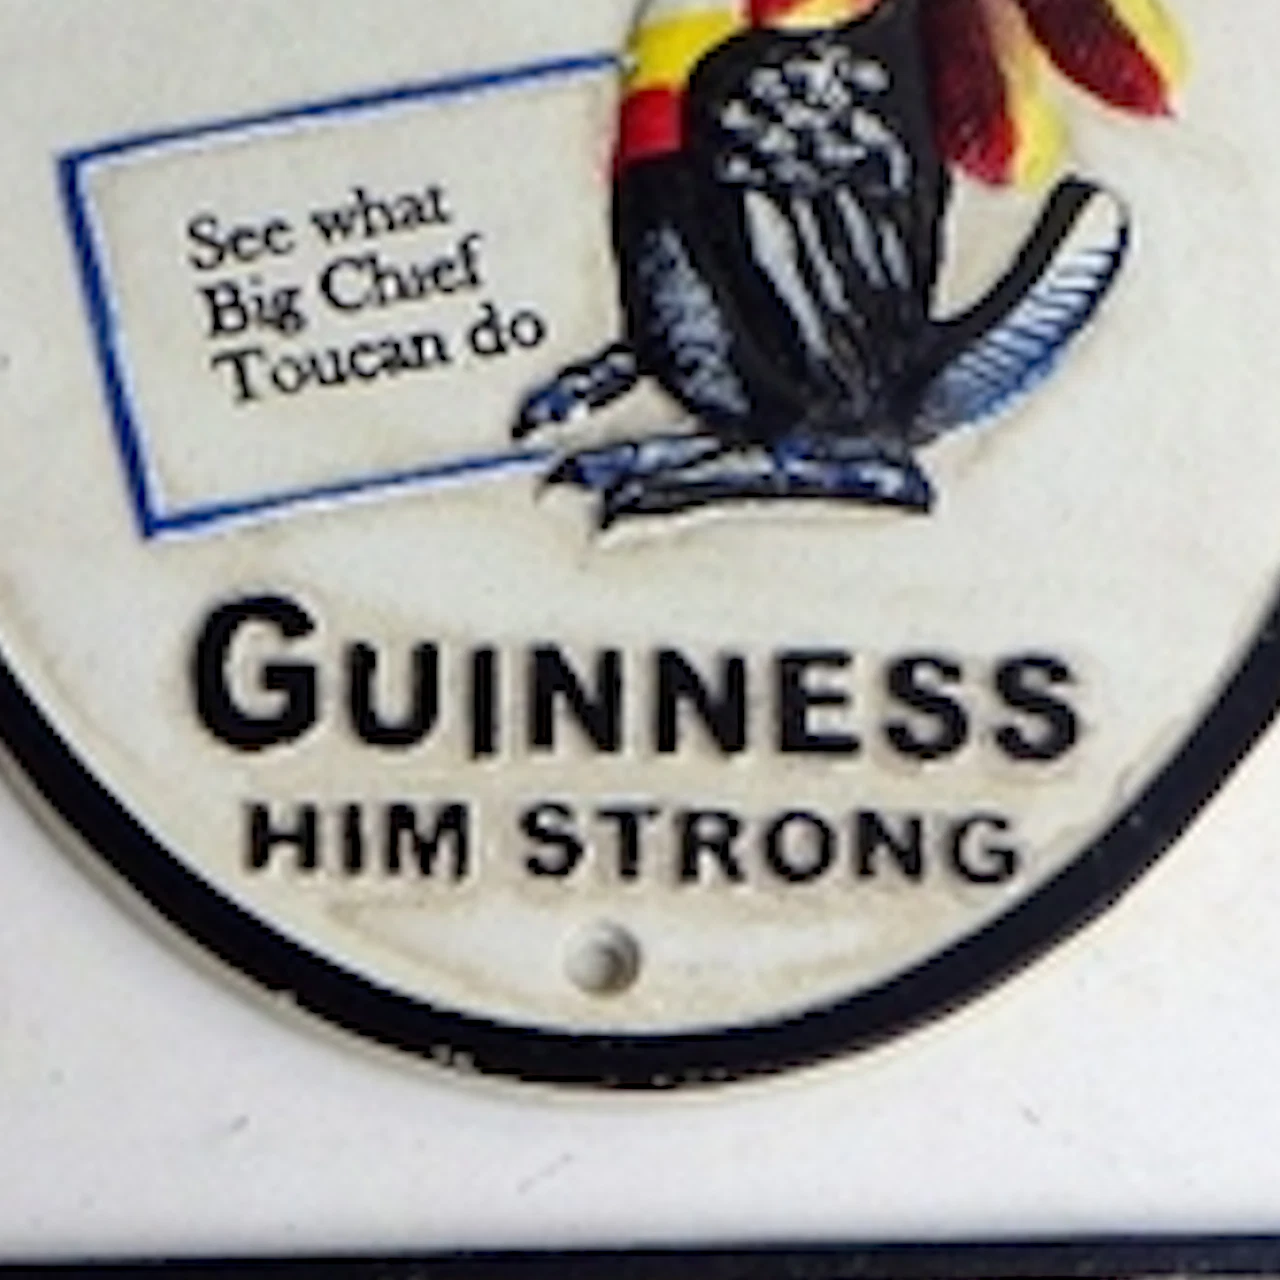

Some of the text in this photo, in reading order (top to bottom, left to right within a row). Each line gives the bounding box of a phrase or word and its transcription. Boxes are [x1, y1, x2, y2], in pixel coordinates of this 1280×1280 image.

[187, 186, 452, 270] See what
[198, 233, 481, 338] Big Chief
[211, 303, 545, 401] Toucan do
[188, 593, 1079, 763] GUINNESS
[245, 801, 1020, 886] HIM STRONG
